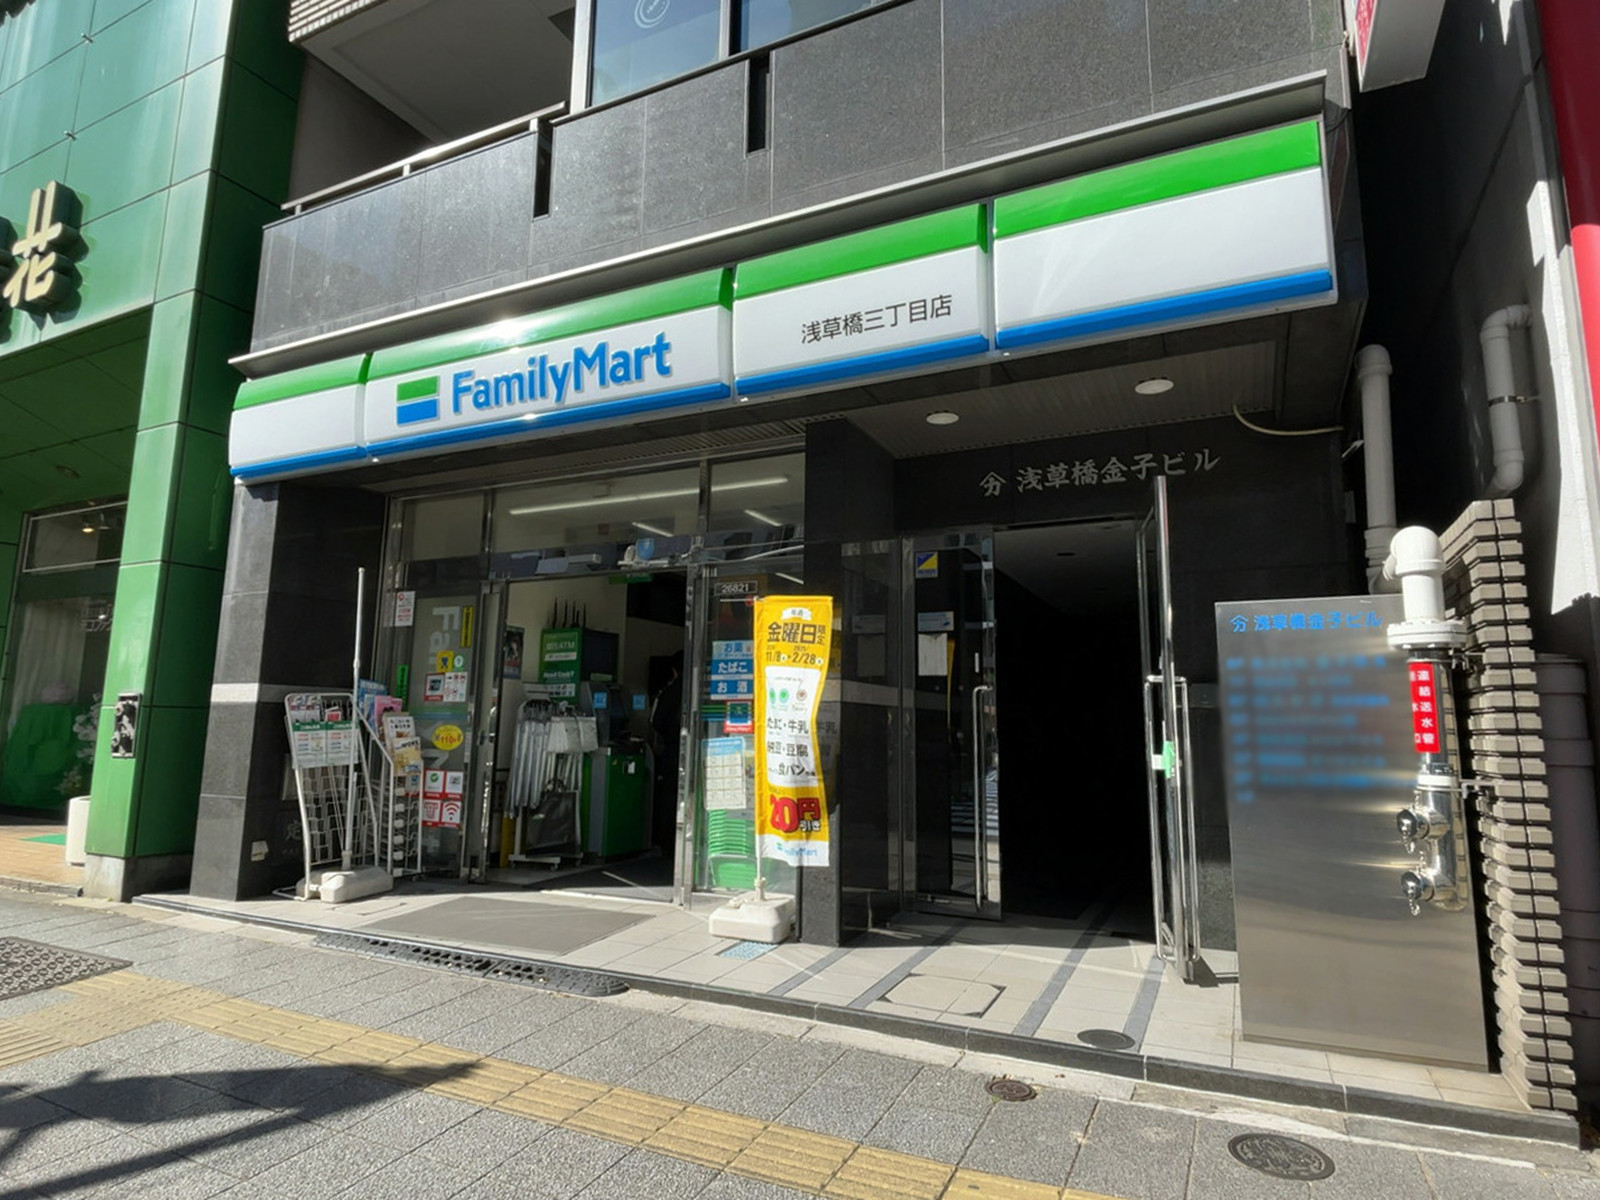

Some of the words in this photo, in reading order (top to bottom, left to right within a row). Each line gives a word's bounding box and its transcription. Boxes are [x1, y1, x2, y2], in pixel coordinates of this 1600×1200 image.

[3, 180, 63, 308] 花
[801, 294, 952, 344] 浅草橋三丁目店
[452, 331, 672, 415] FamilyMart
[1016, 448, 1220, 493] 浅草橋金子ビル
[721, 583, 749, 594] 26821
[767, 621, 817, 644] 金曜日
[1254, 611, 1384, 631] 浅草橋金子ビル
[718, 661, 748, 673] たばこ
